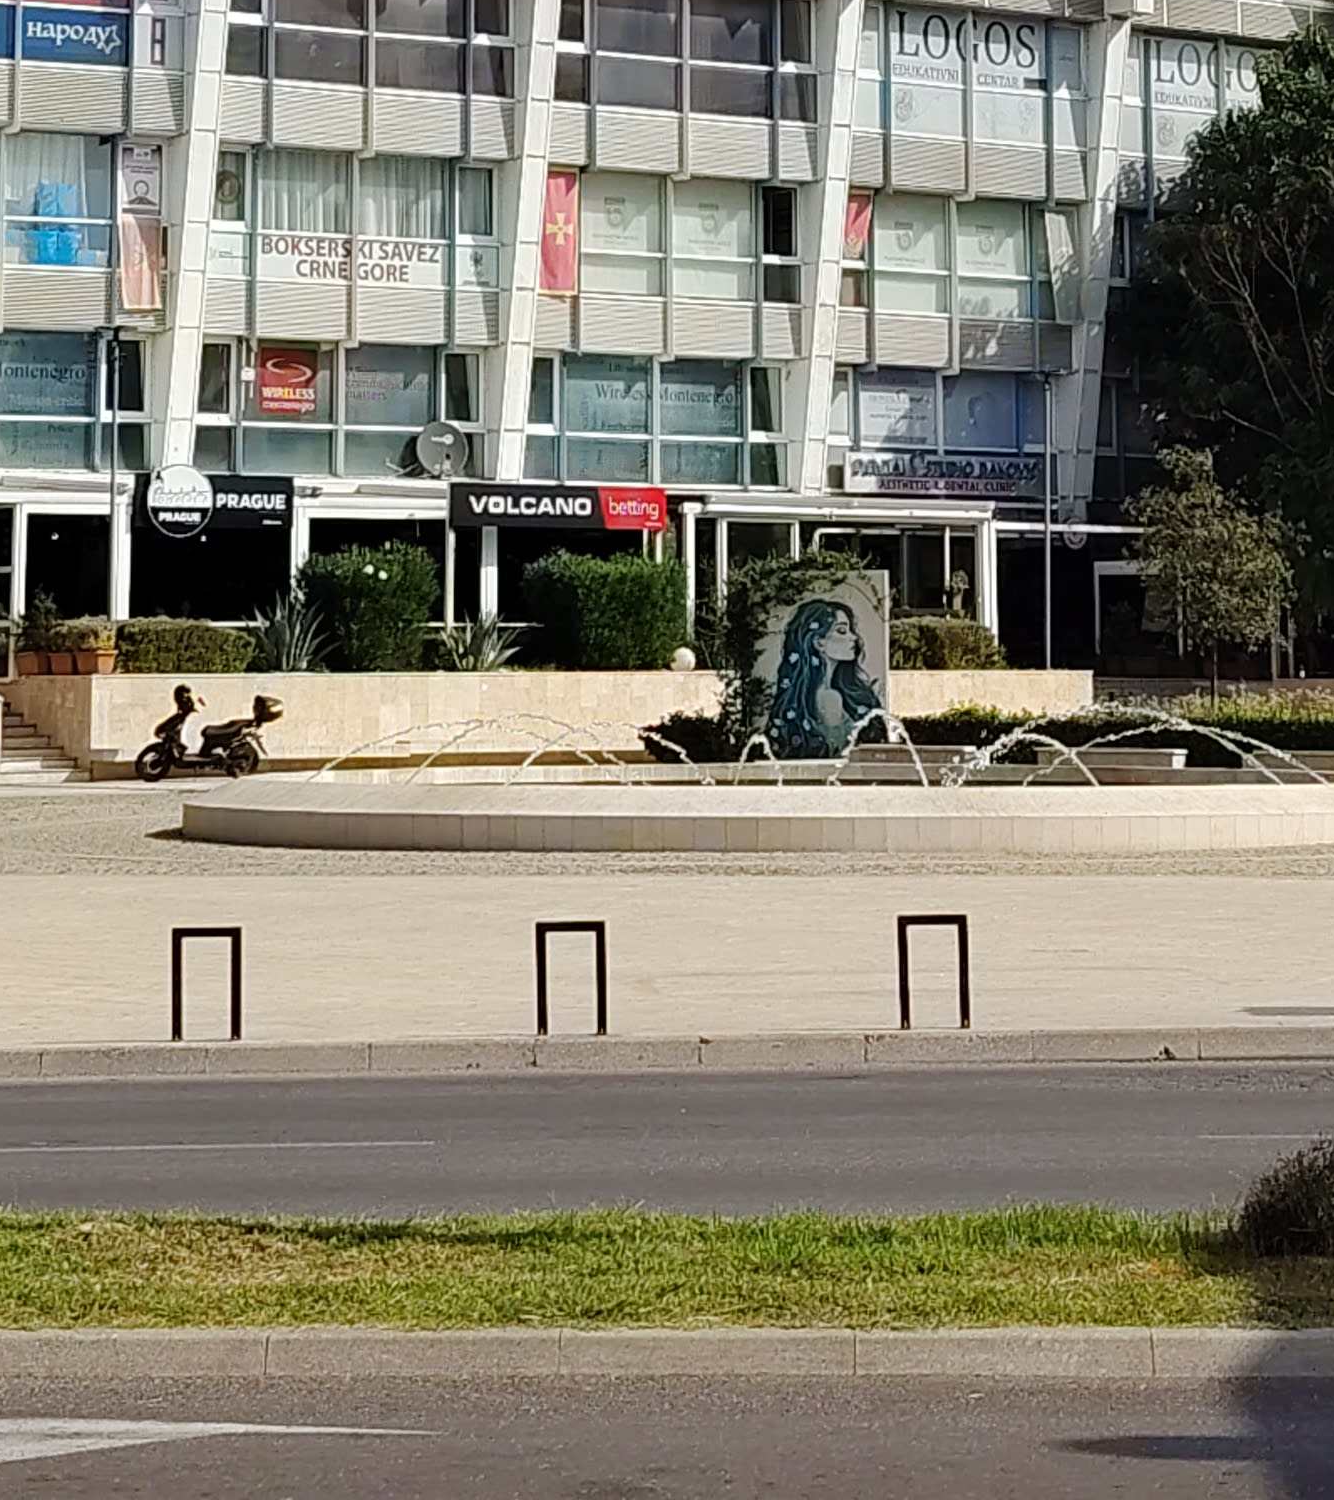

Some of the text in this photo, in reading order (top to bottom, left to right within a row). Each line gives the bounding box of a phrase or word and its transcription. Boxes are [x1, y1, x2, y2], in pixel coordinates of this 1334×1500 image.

[896, 10, 1036, 68] LOGOS
[893, 63, 1019, 89] EDUKATIVNI CENTAR
[1154, 40, 1258, 93] LOGO
[261, 236, 440, 263] BOKSERSKI SAVEZ
[296, 259, 409, 282] CRNE GORE
[215, 493, 287, 510] PRAGUE
[468, 494, 660, 520] VOLCANO betting
[158, 511, 202, 522] PRAGUE
